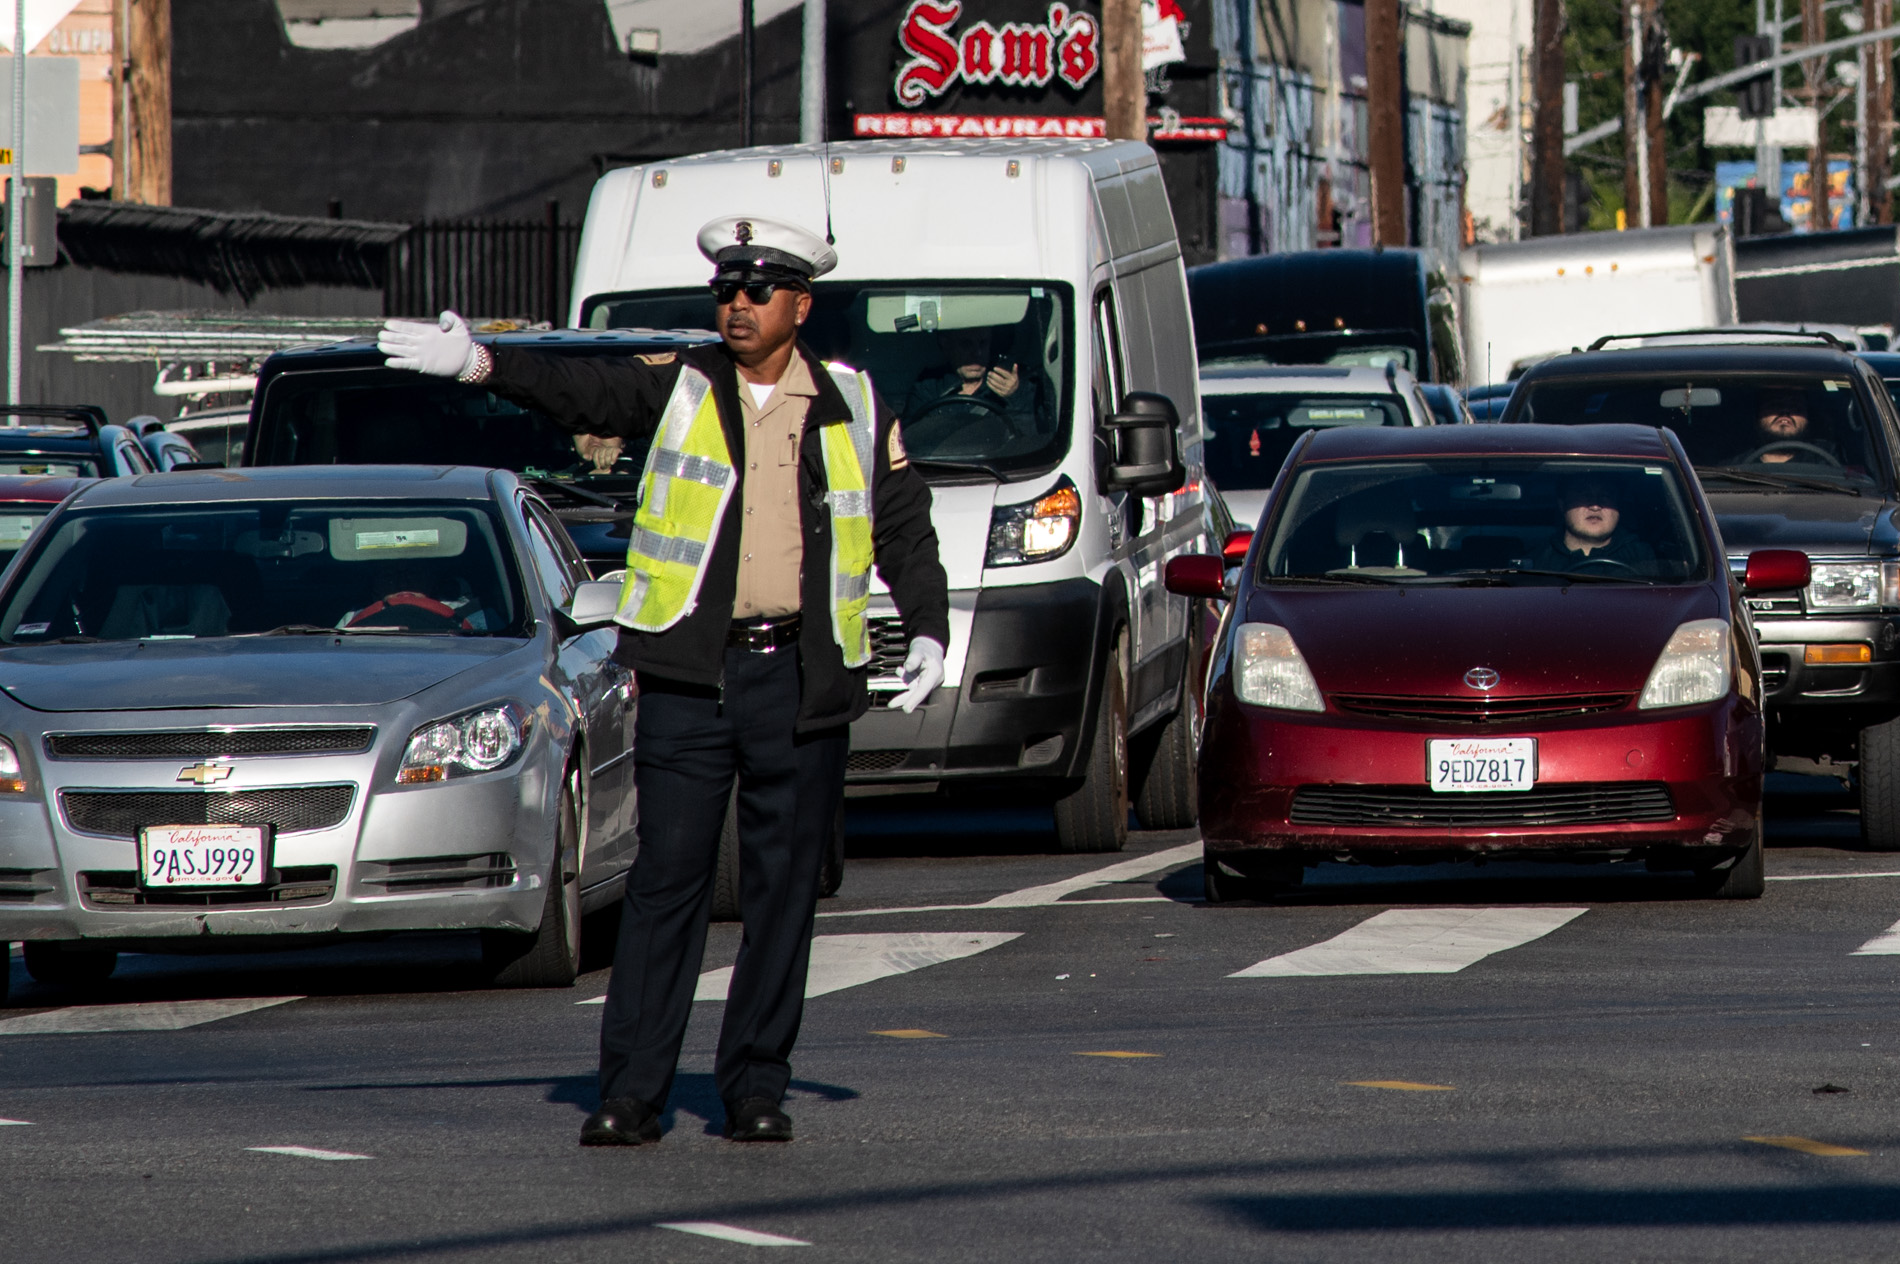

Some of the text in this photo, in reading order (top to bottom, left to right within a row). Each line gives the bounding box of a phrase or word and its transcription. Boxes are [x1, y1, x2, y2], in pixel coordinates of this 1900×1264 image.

[1453, 743, 1513, 758] California
[1439, 759, 1525, 783] 9EDZ817
[169, 830, 240, 847] California
[152, 848, 255, 877] 9ASJ999
